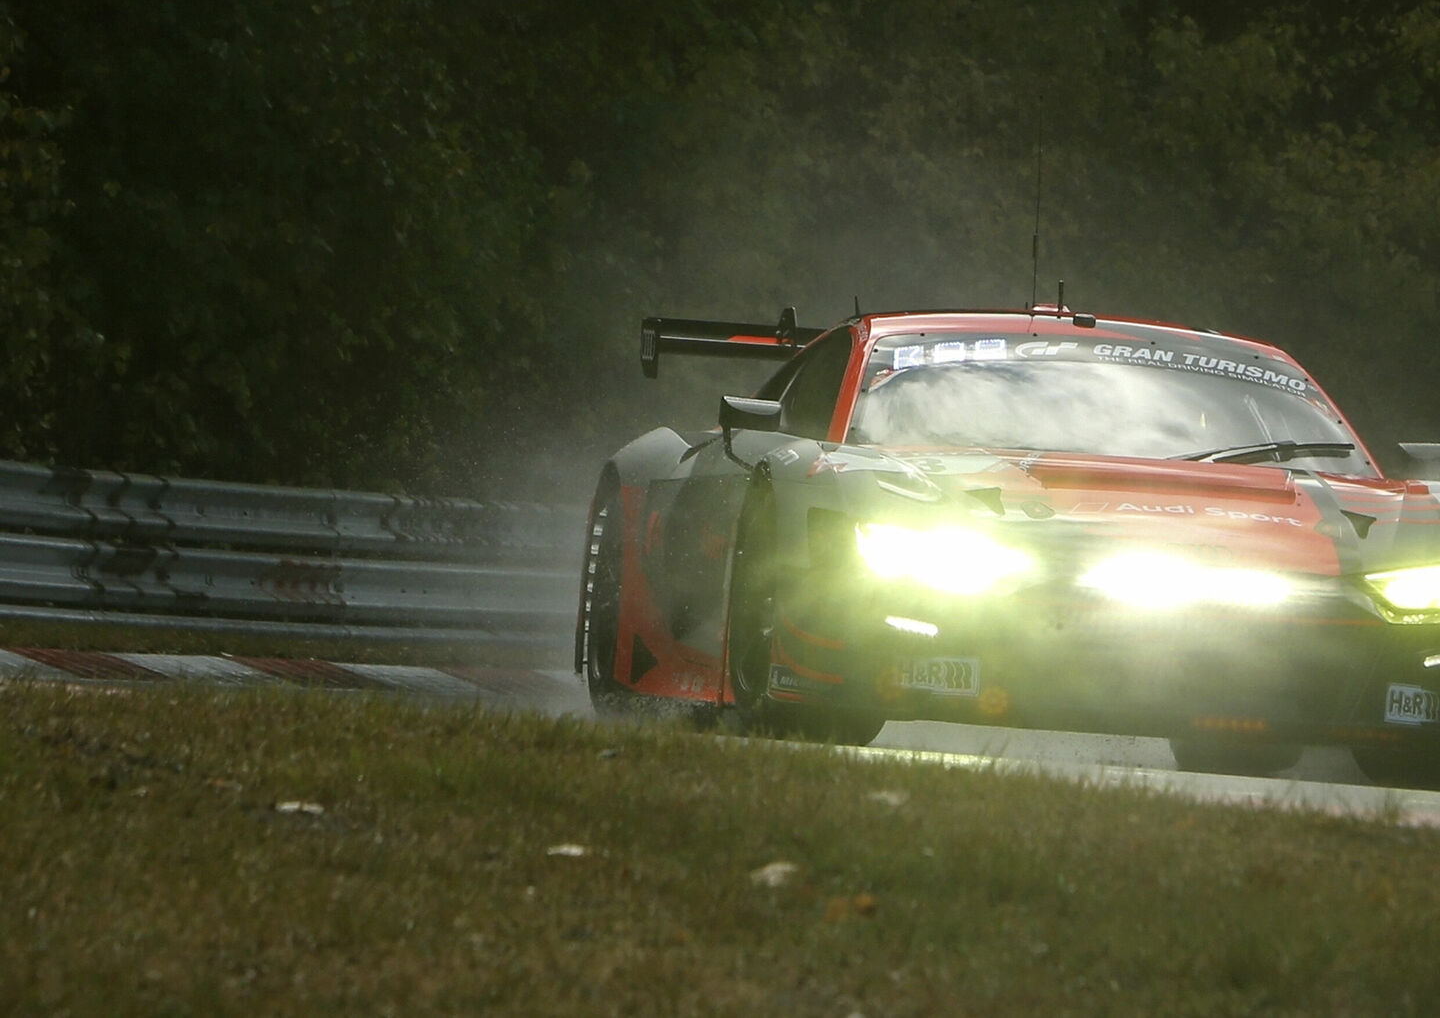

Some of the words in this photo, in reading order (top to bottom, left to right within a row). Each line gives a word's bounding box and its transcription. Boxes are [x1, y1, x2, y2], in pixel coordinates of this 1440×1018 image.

[1093, 344, 1174, 362] GRAN
[1183, 353, 1307, 392] TURISMO
[1128, 358, 1166, 368] REAL
[1167, 362, 1226, 377] DRIVING
[1228, 372, 1306, 398] SIMULATOR
[1116, 502, 1194, 515] Audi
[1204, 507, 1303, 528] Sport
[1389, 689, 1423, 716] H&R
